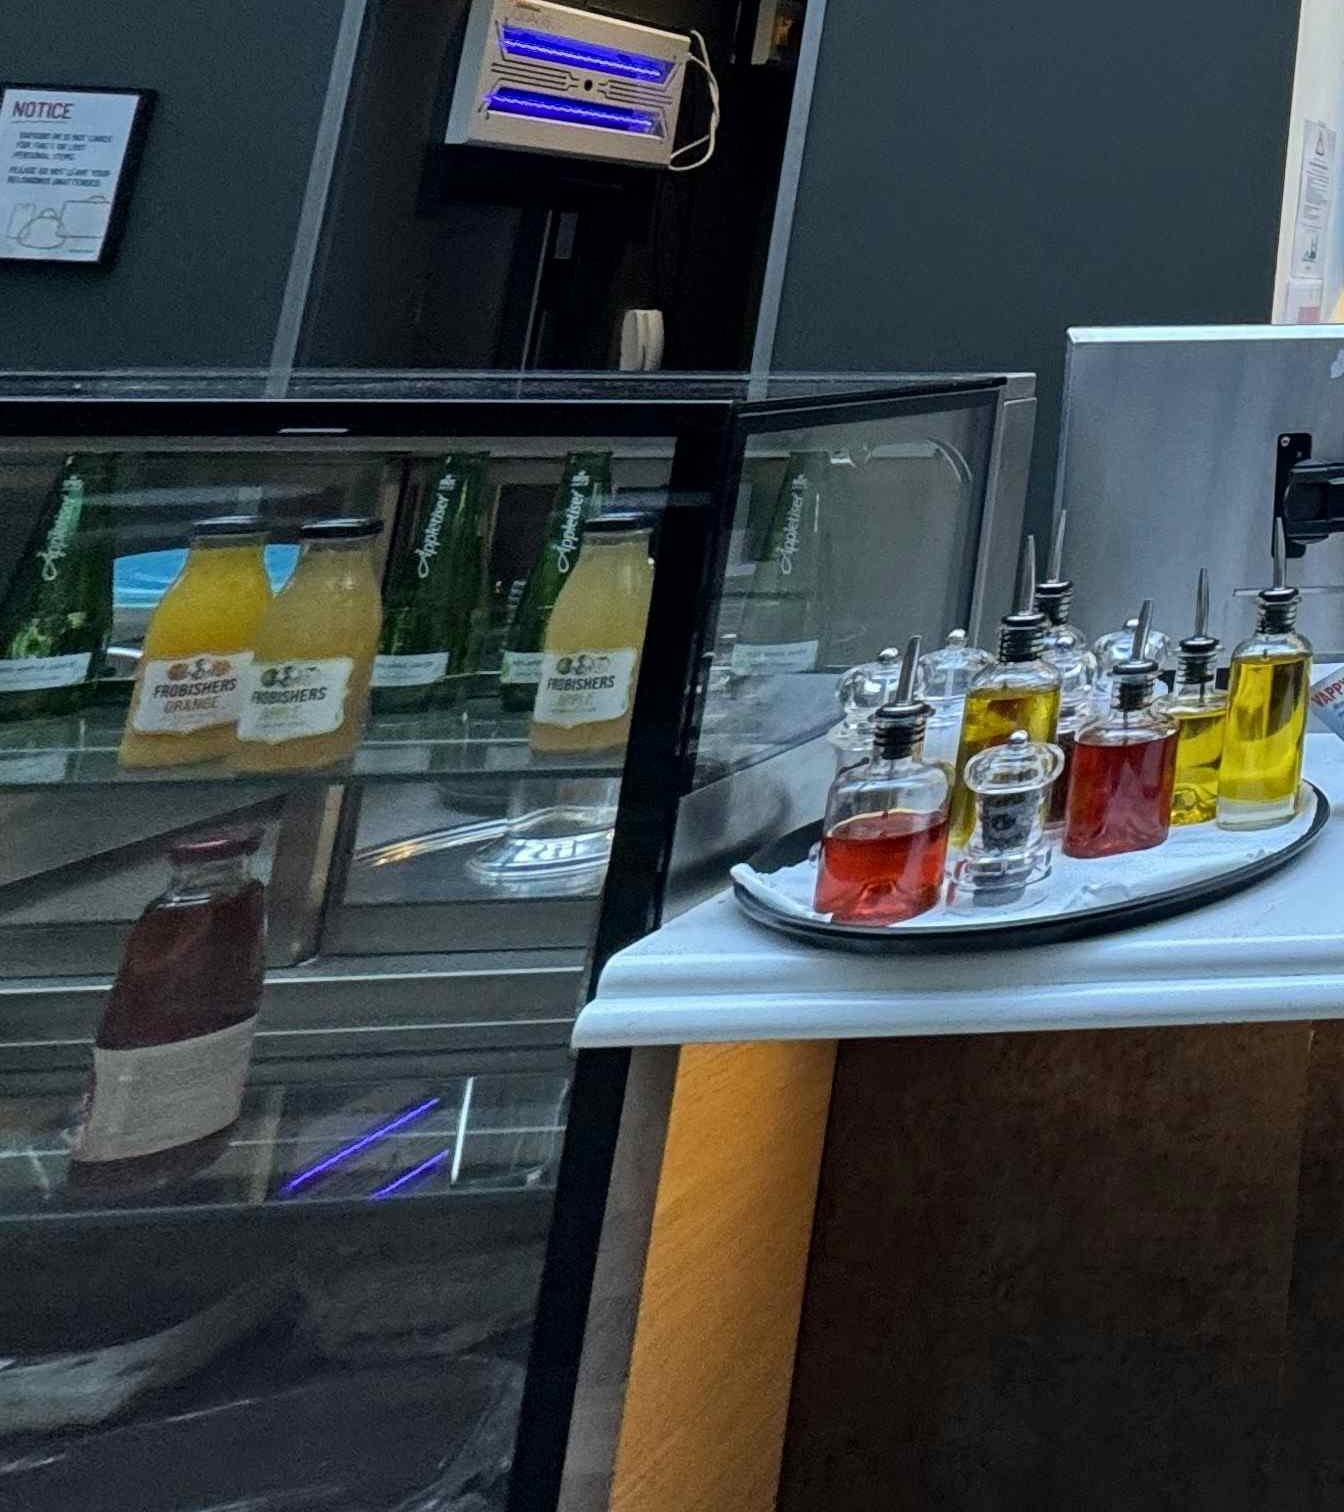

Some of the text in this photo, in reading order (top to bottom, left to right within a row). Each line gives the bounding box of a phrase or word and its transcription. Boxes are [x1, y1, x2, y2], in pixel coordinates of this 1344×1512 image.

[12, 100, 75, 120] NOTICE
[415, 492, 450, 579] Appletiser
[554, 491, 586, 574] Appletiser
